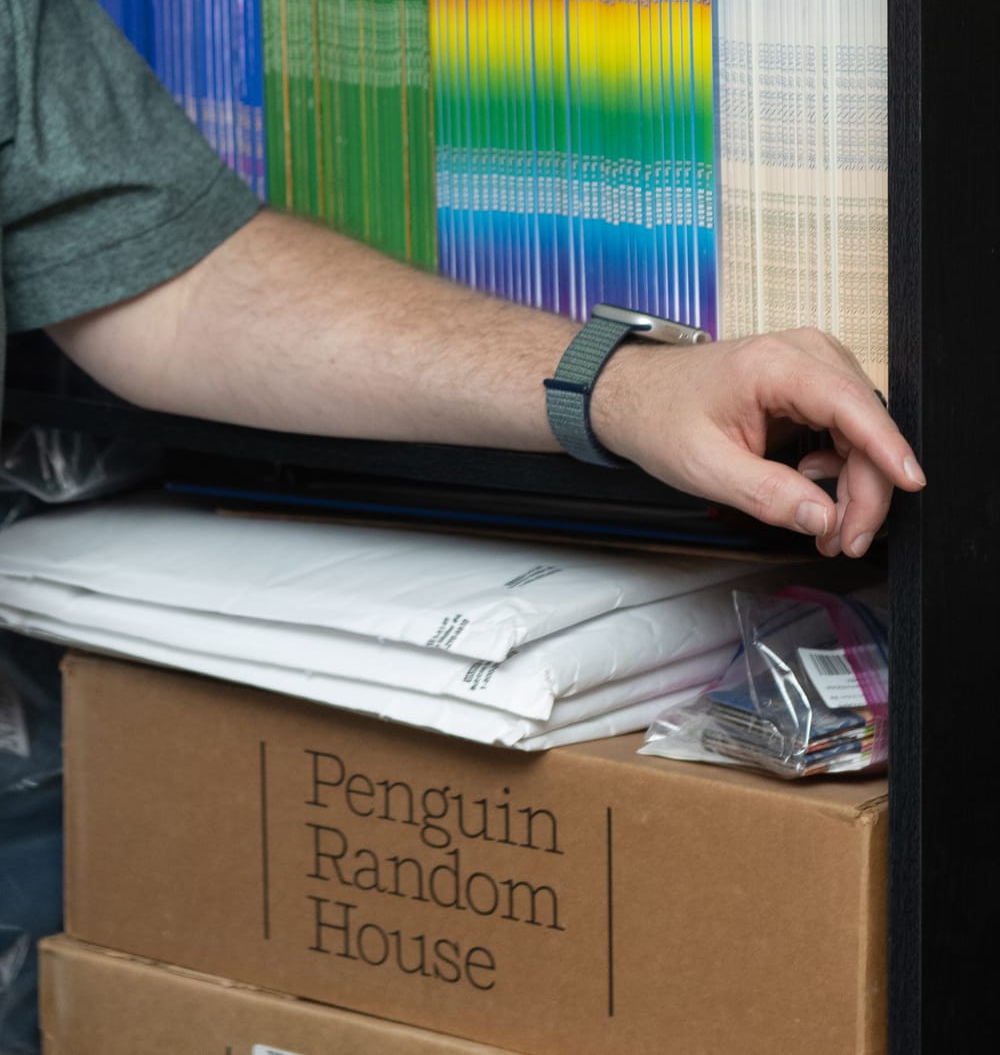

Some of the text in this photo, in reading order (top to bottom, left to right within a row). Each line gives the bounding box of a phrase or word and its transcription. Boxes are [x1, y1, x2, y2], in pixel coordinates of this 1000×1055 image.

[304, 748, 566, 857] Penguin
[306, 822, 566, 931] Random
[308, 894, 497, 991] House
